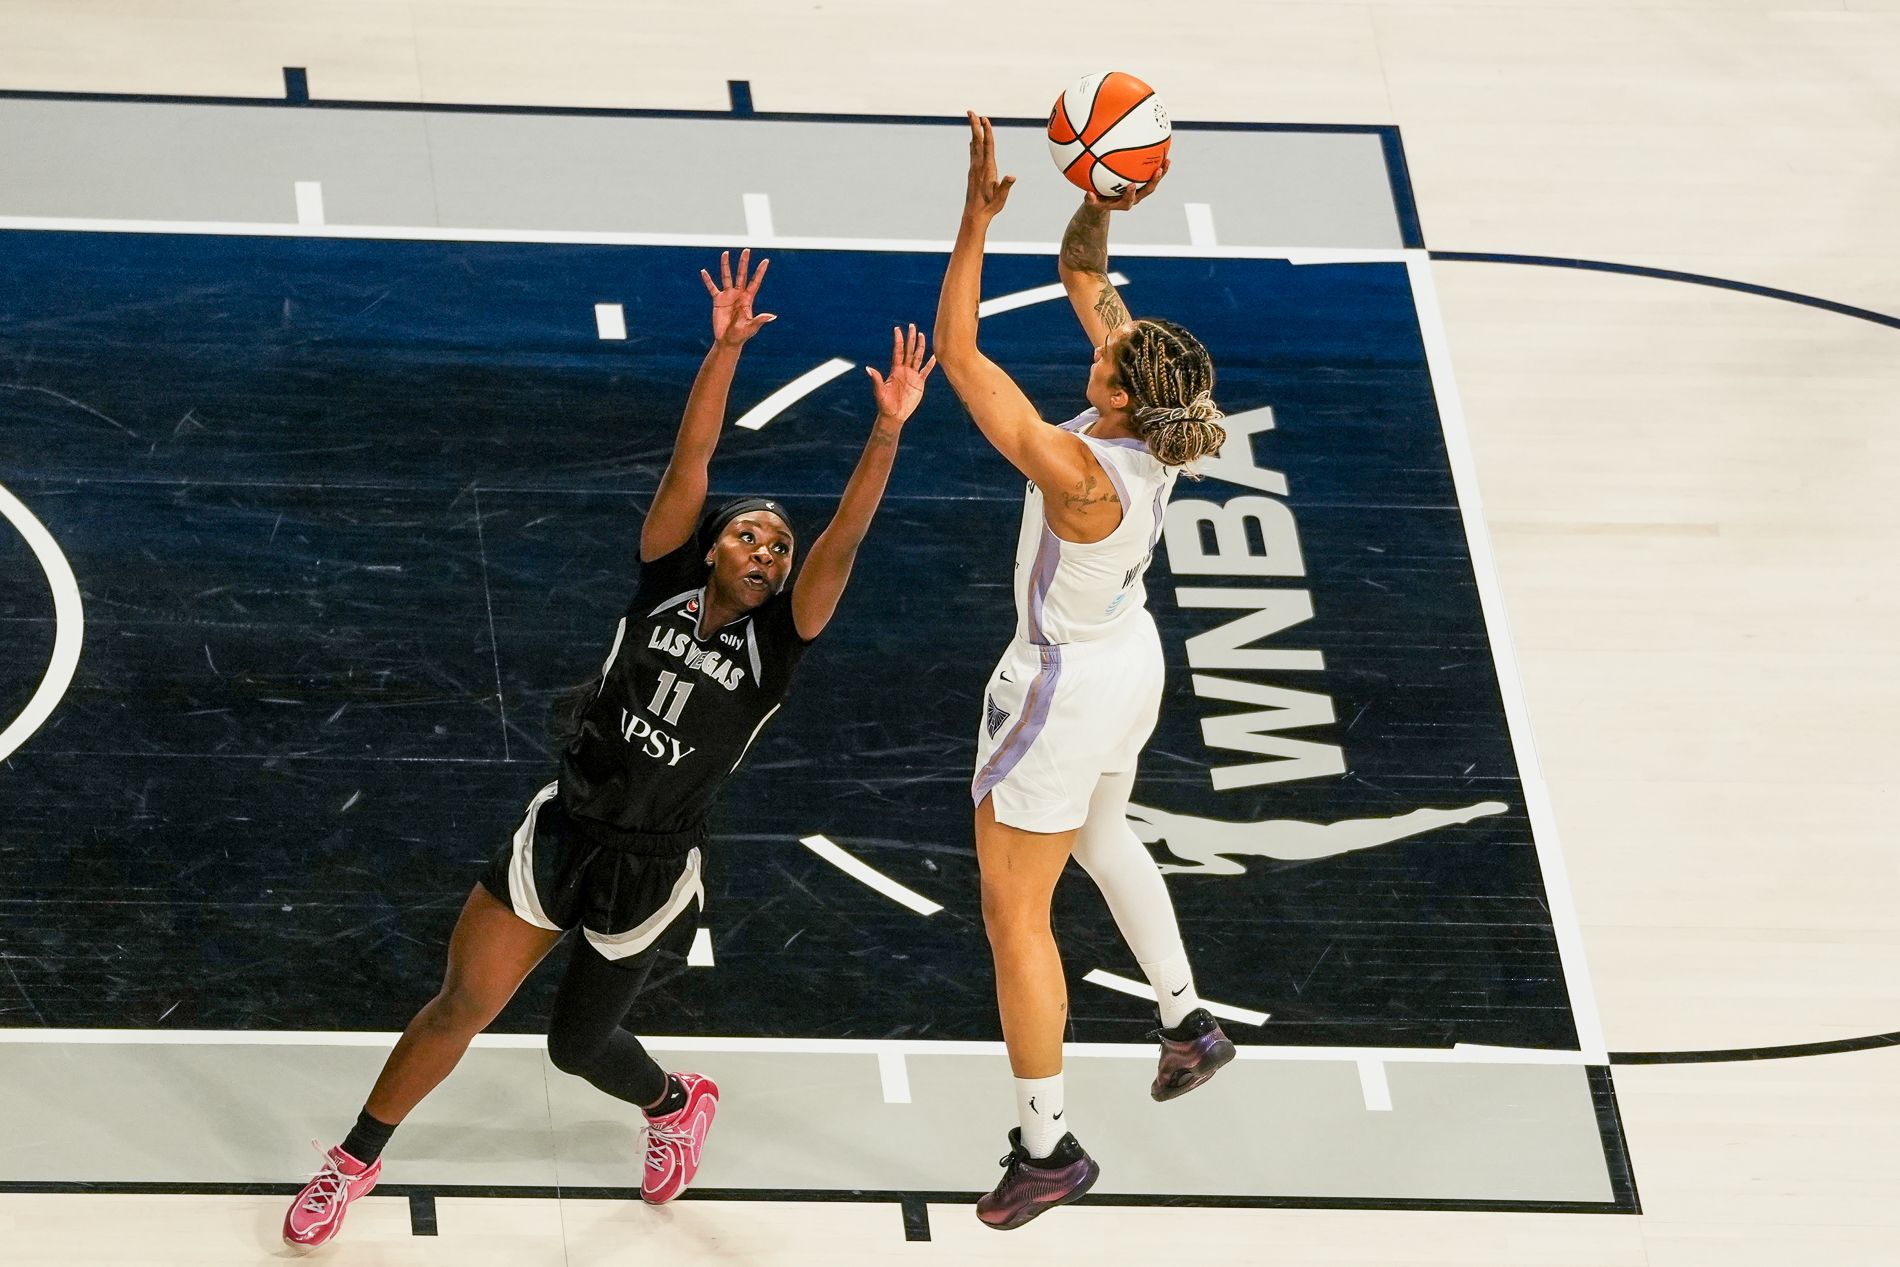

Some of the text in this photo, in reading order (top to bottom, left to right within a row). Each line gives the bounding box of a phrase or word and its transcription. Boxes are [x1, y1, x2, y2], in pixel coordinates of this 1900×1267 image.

[1163, 406, 1346, 791] WNBA
[720, 633, 744, 651] ally
[647, 669, 695, 726] 11
